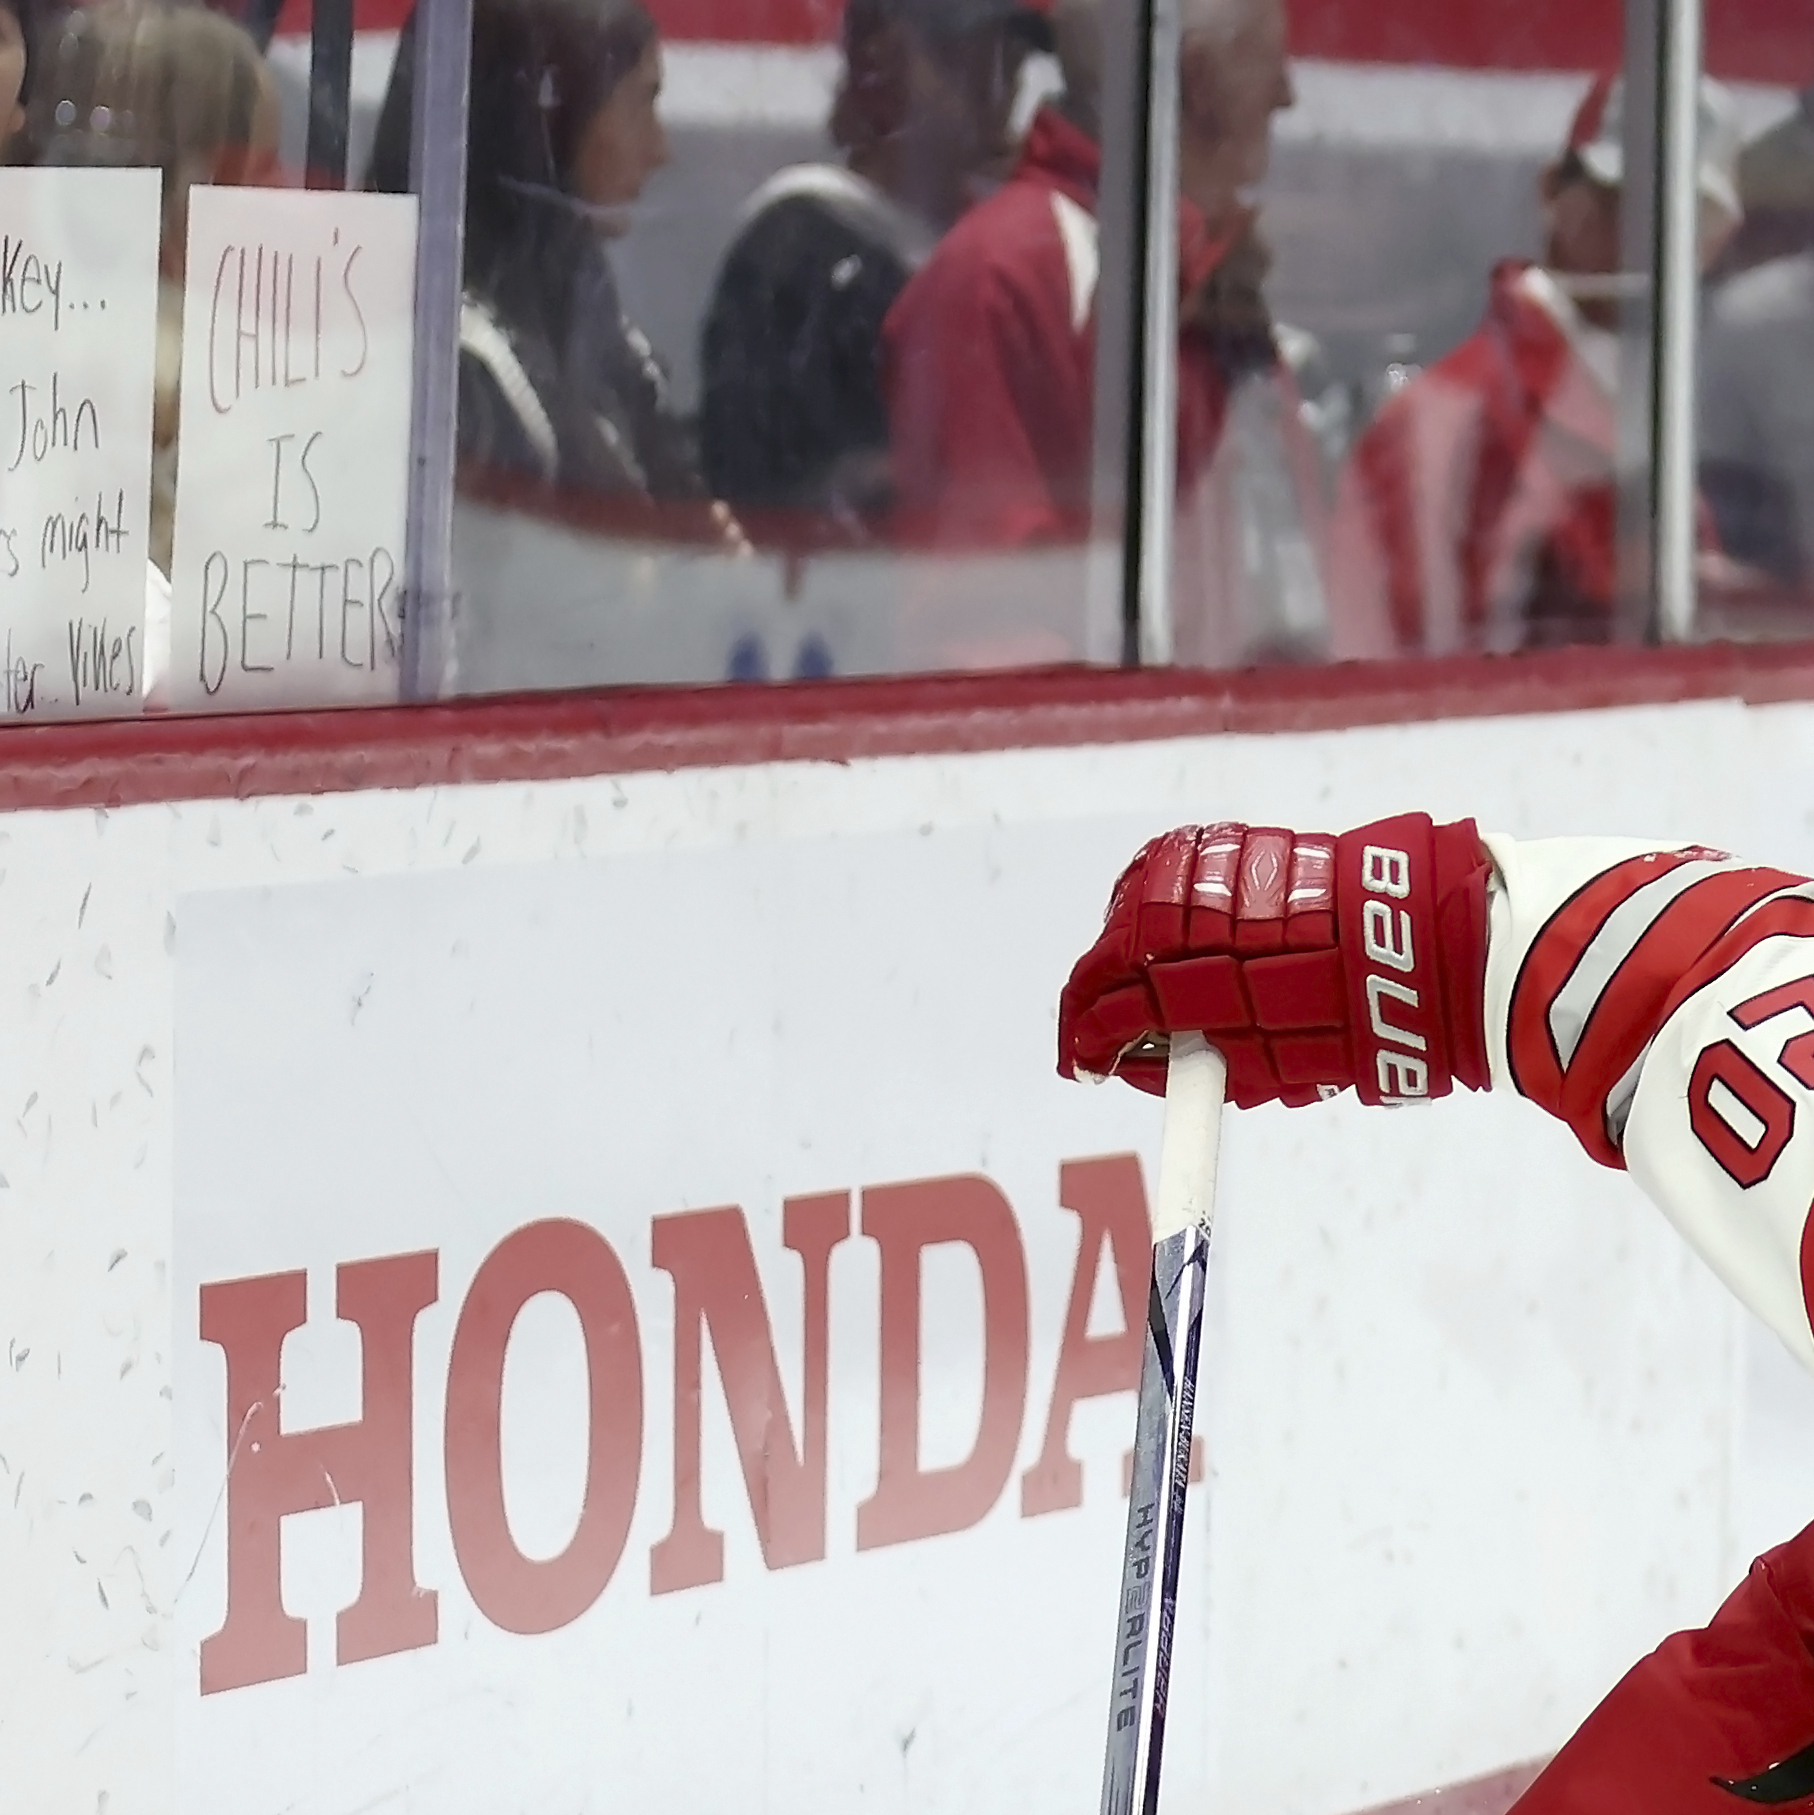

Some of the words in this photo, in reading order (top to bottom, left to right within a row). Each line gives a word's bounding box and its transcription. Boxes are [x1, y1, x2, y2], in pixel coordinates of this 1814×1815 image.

[209, 226, 368, 414] CHILI'S
[8, 371, 100, 472] John
[262, 431, 323, 533] IS
[199, 546, 396, 696] BETTER
[1362, 845, 1433, 1108] BAUE
[199, 1150, 1205, 1696] HONDA
